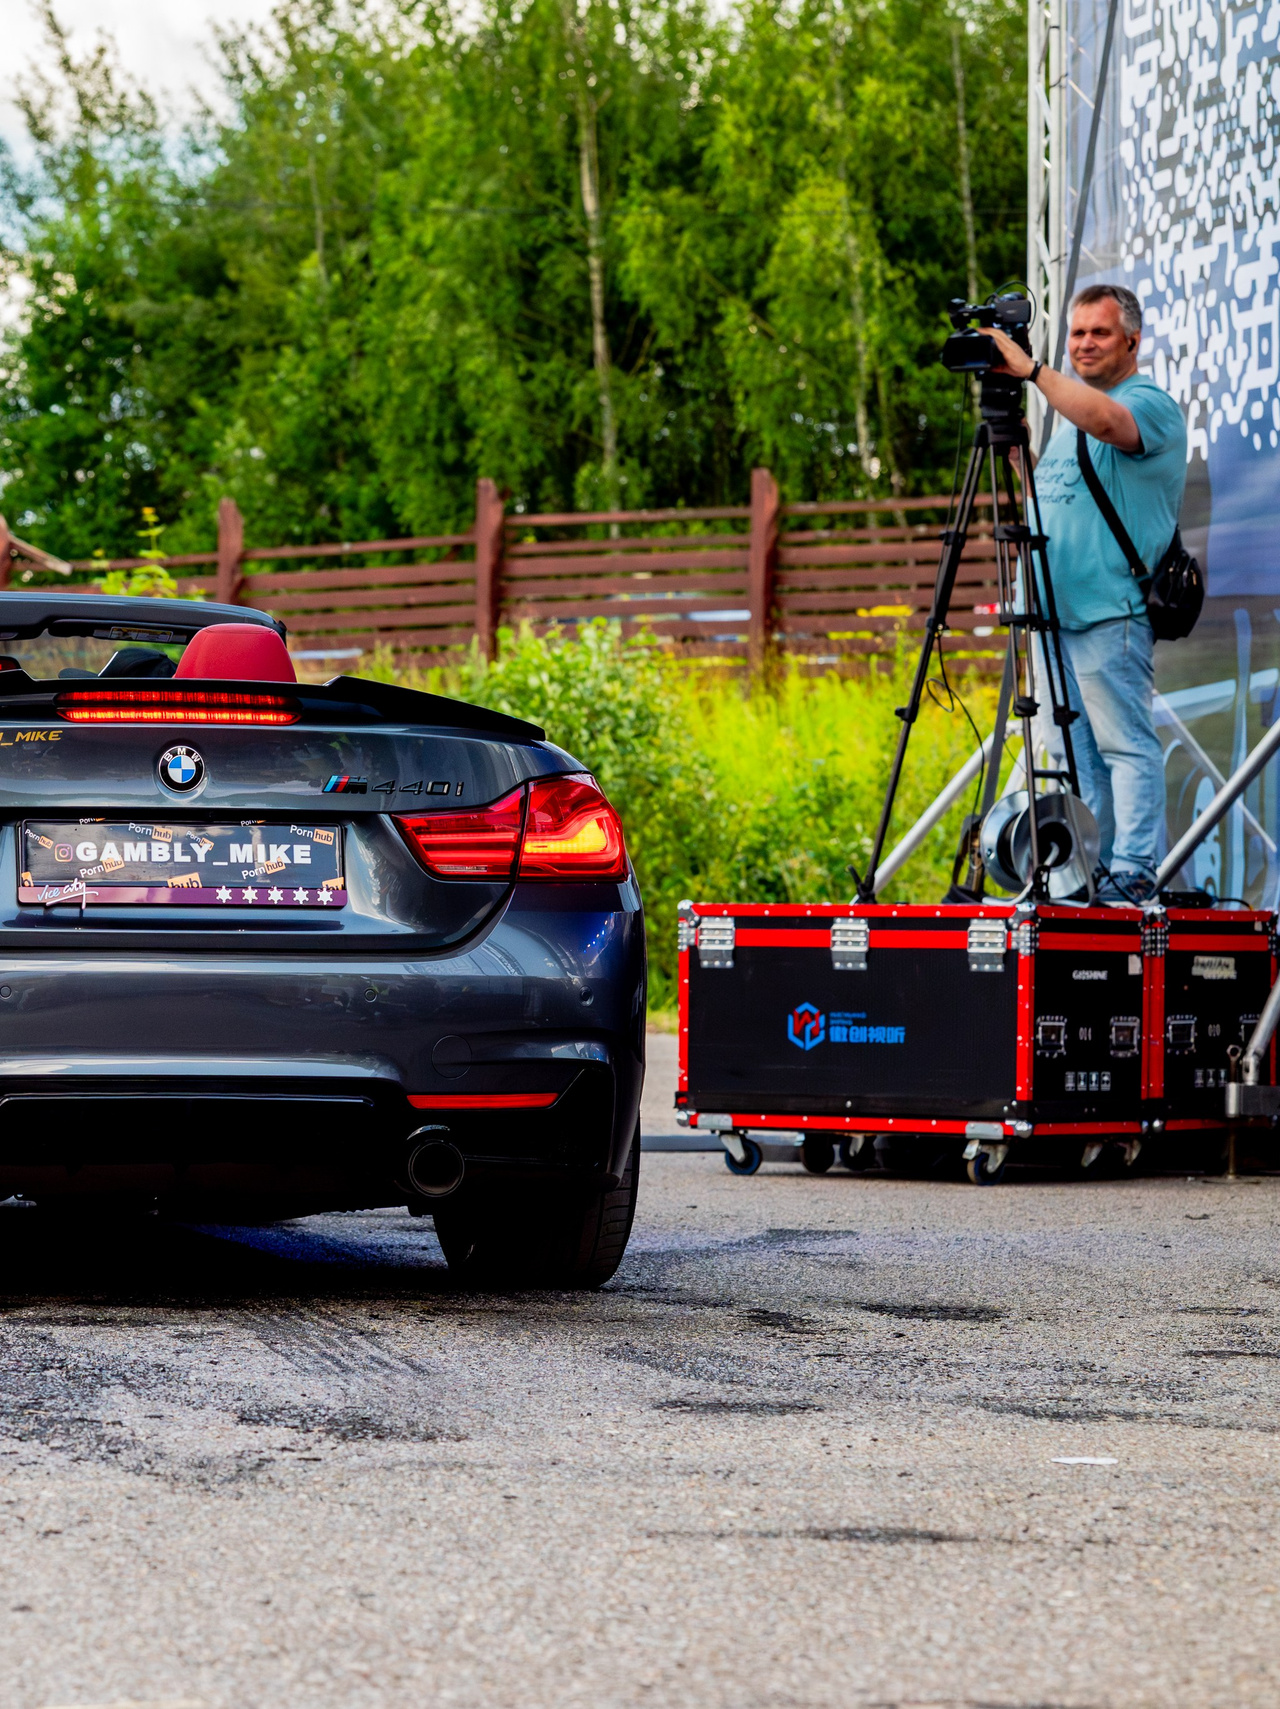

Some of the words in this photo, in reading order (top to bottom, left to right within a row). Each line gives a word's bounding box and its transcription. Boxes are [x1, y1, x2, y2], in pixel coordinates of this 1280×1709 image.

[163, 747, 201, 762] BMW
[371, 780, 464, 797] 440i
[76, 841, 311, 866] GAMBLY_MIKE
